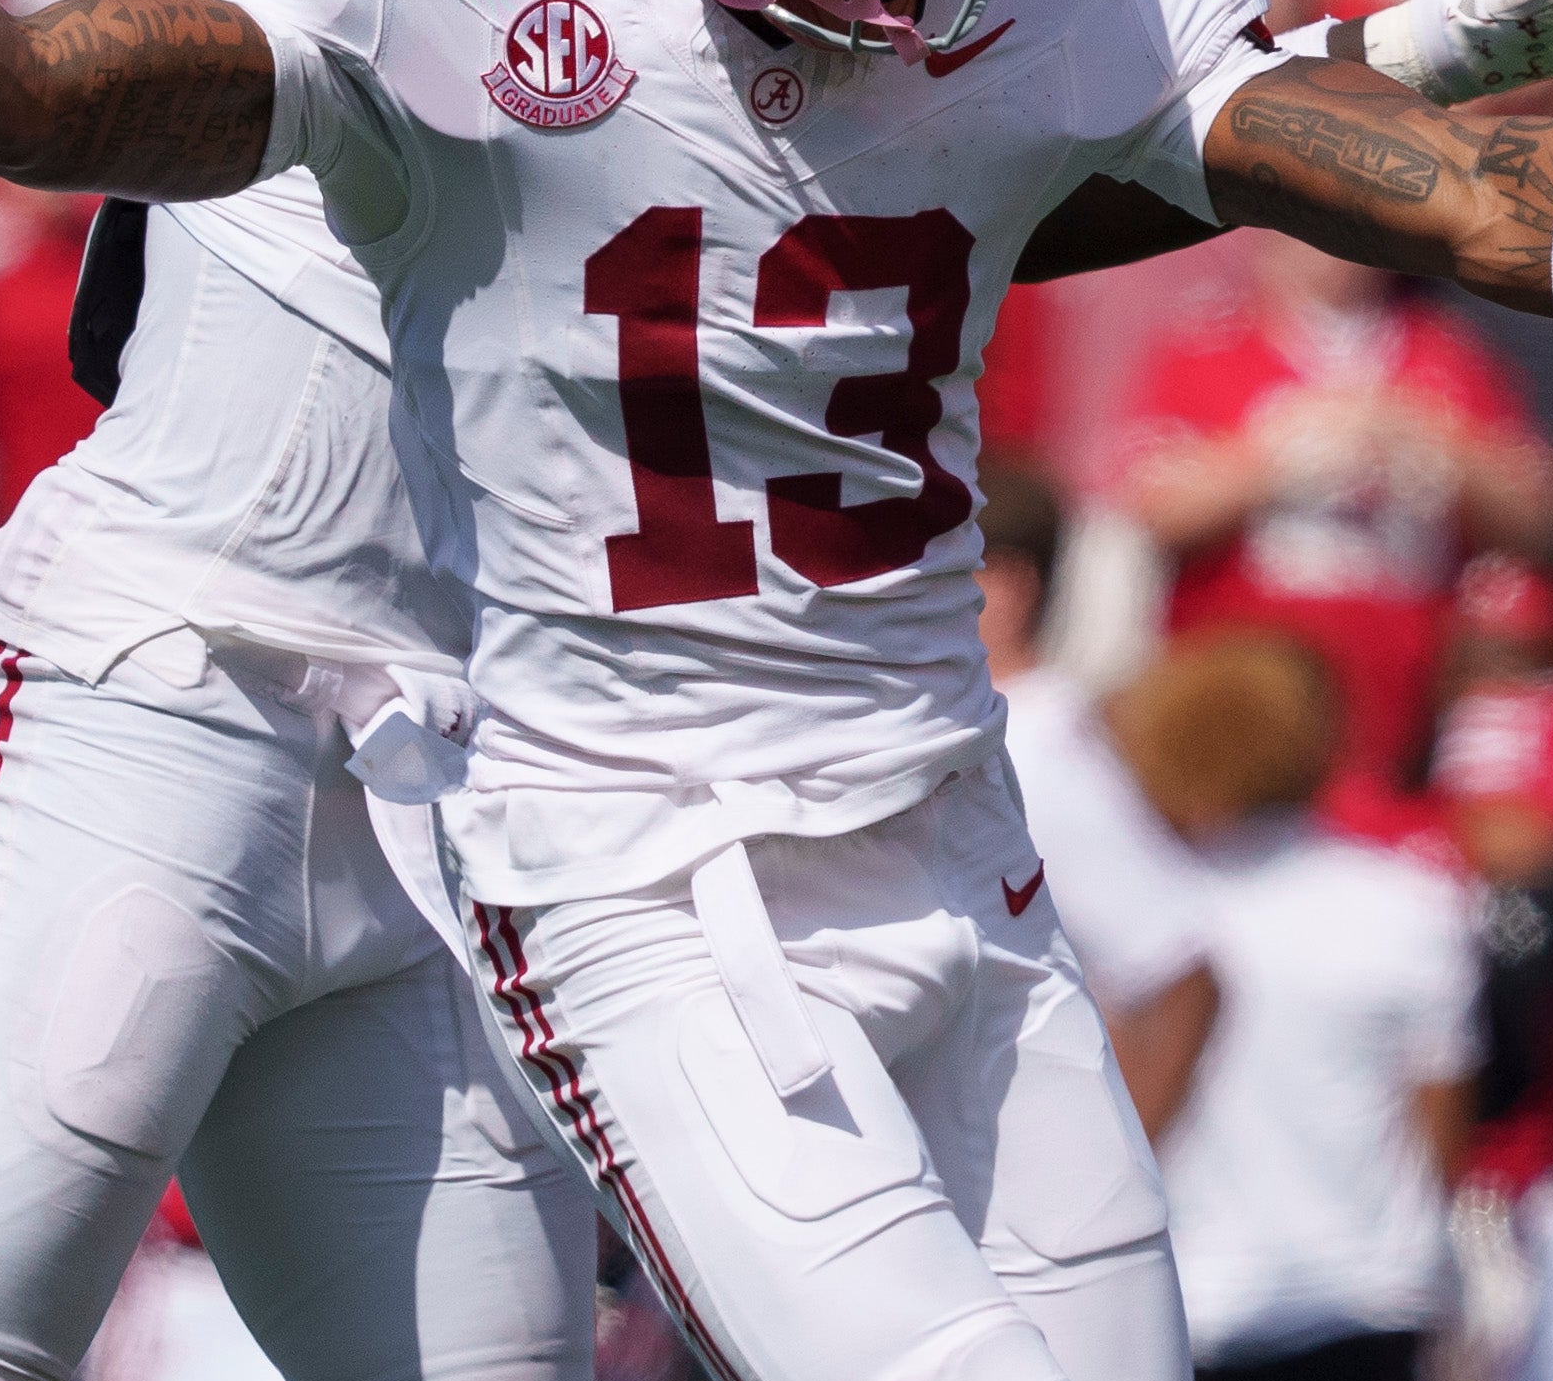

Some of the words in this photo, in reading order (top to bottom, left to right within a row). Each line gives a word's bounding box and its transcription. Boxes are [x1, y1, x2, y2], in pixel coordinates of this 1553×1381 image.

[511, 0, 604, 96] SEC
[499, 85, 616, 127] GRADUATE
[583, 205, 974, 613] 13
